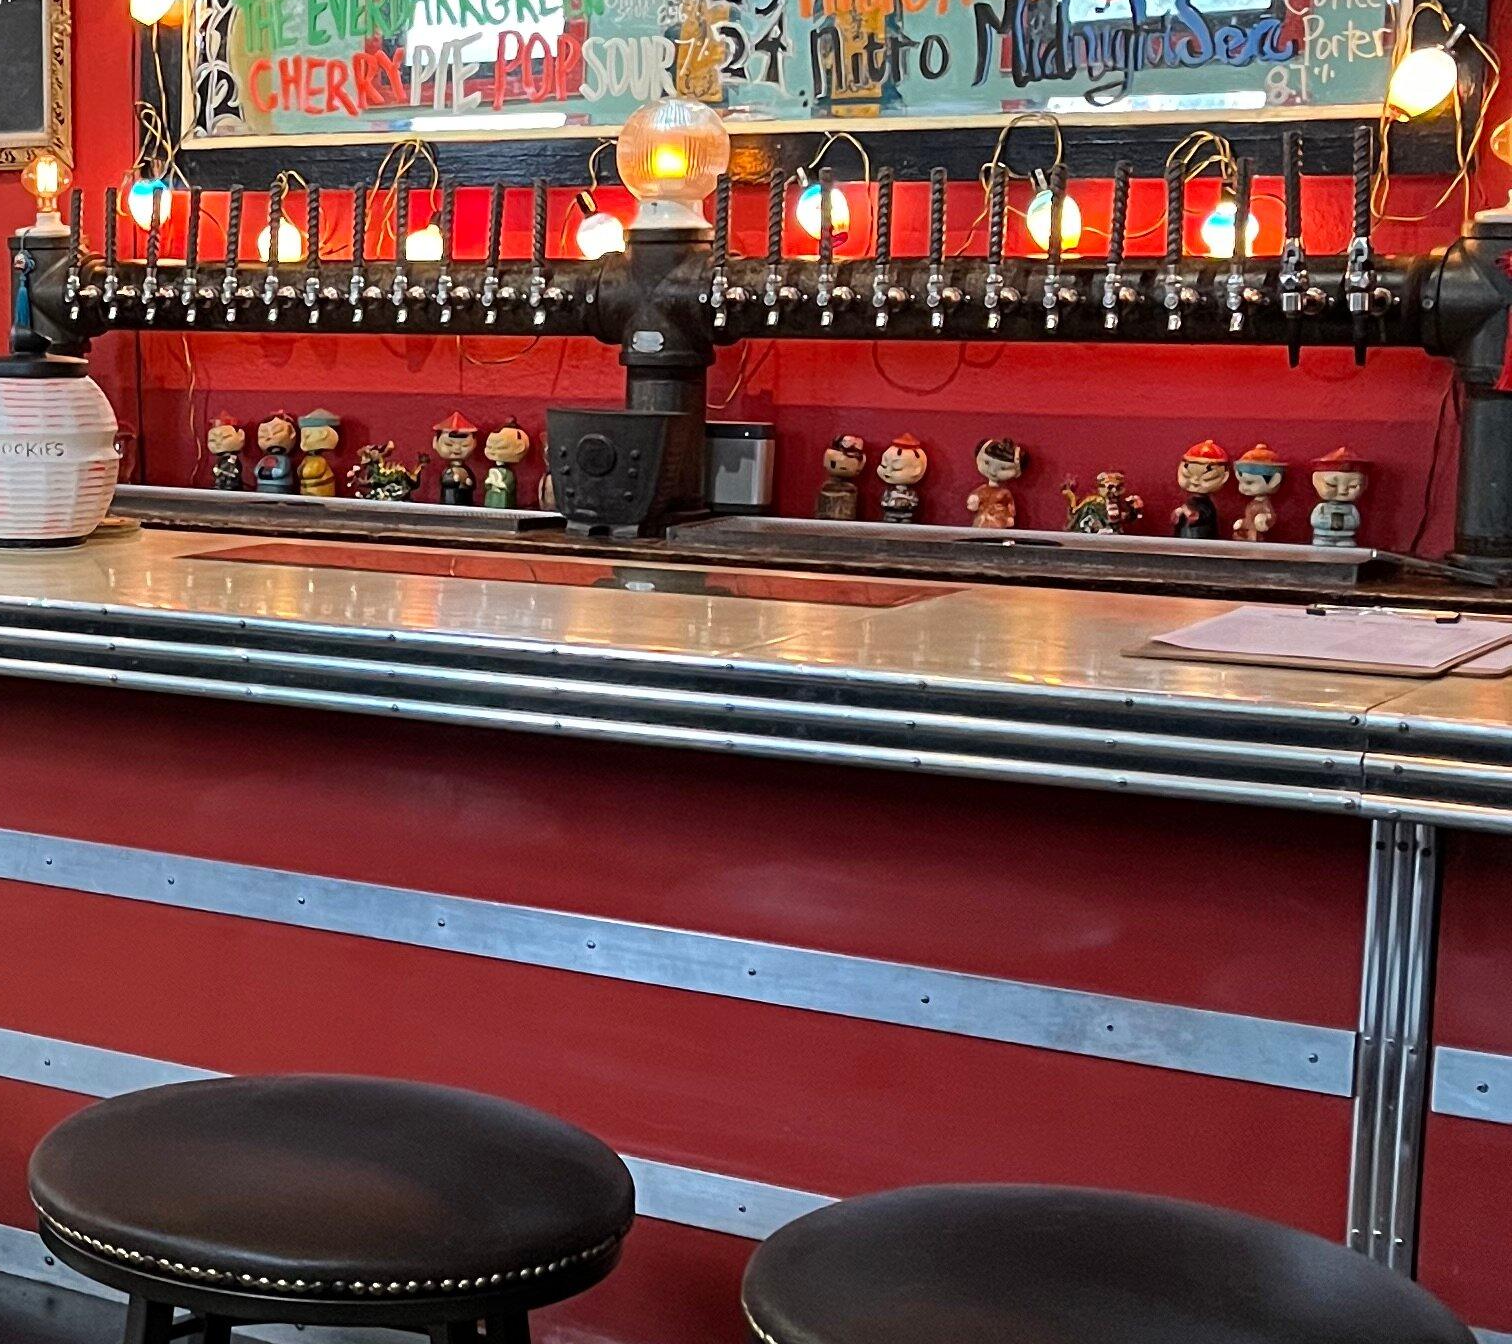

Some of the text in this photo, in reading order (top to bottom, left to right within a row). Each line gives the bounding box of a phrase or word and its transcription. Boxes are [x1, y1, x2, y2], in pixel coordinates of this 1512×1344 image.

[248, 46, 409, 118] CHERRY
[409, 31, 483, 113] PIE
[491, 28, 582, 112] POP
[579, 36, 677, 102] SOUR
[1302, 14, 1393, 66] Porter
